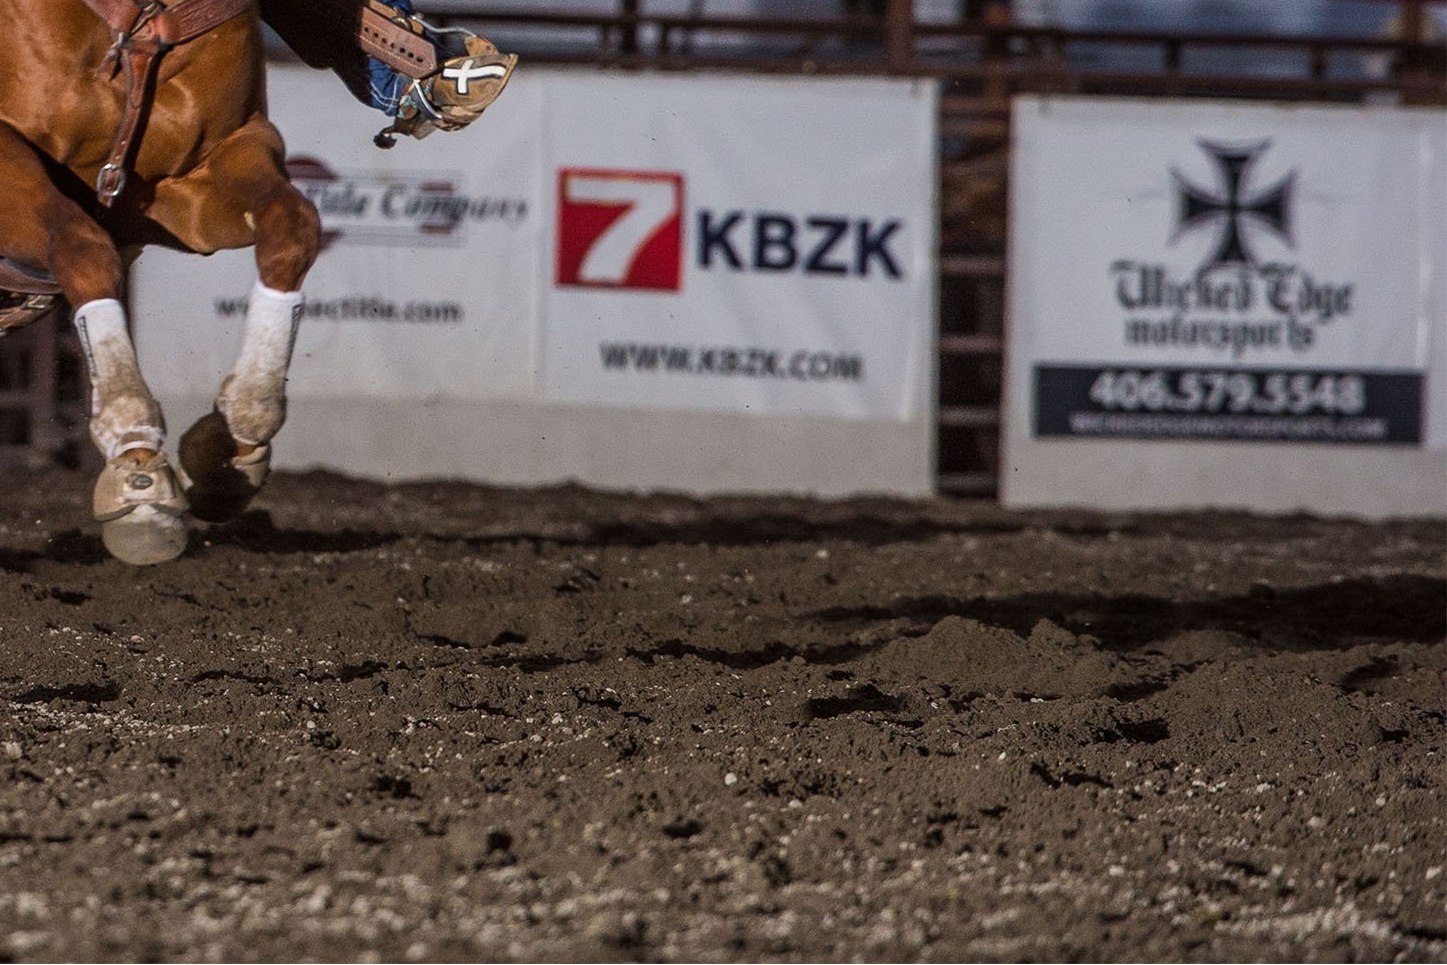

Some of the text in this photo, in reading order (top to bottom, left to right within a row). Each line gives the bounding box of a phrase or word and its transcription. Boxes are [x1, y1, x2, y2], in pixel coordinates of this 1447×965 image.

[380, 186, 528, 225] Company
[566, 176, 905, 284] 7 KBZK
[1109, 259, 1354, 324] Wicked Edge
[1125, 316, 1315, 358] motorsports
[600, 344, 863, 380] WWW.KBZK.COM
[1090, 372, 1365, 413] 406.579.5548
